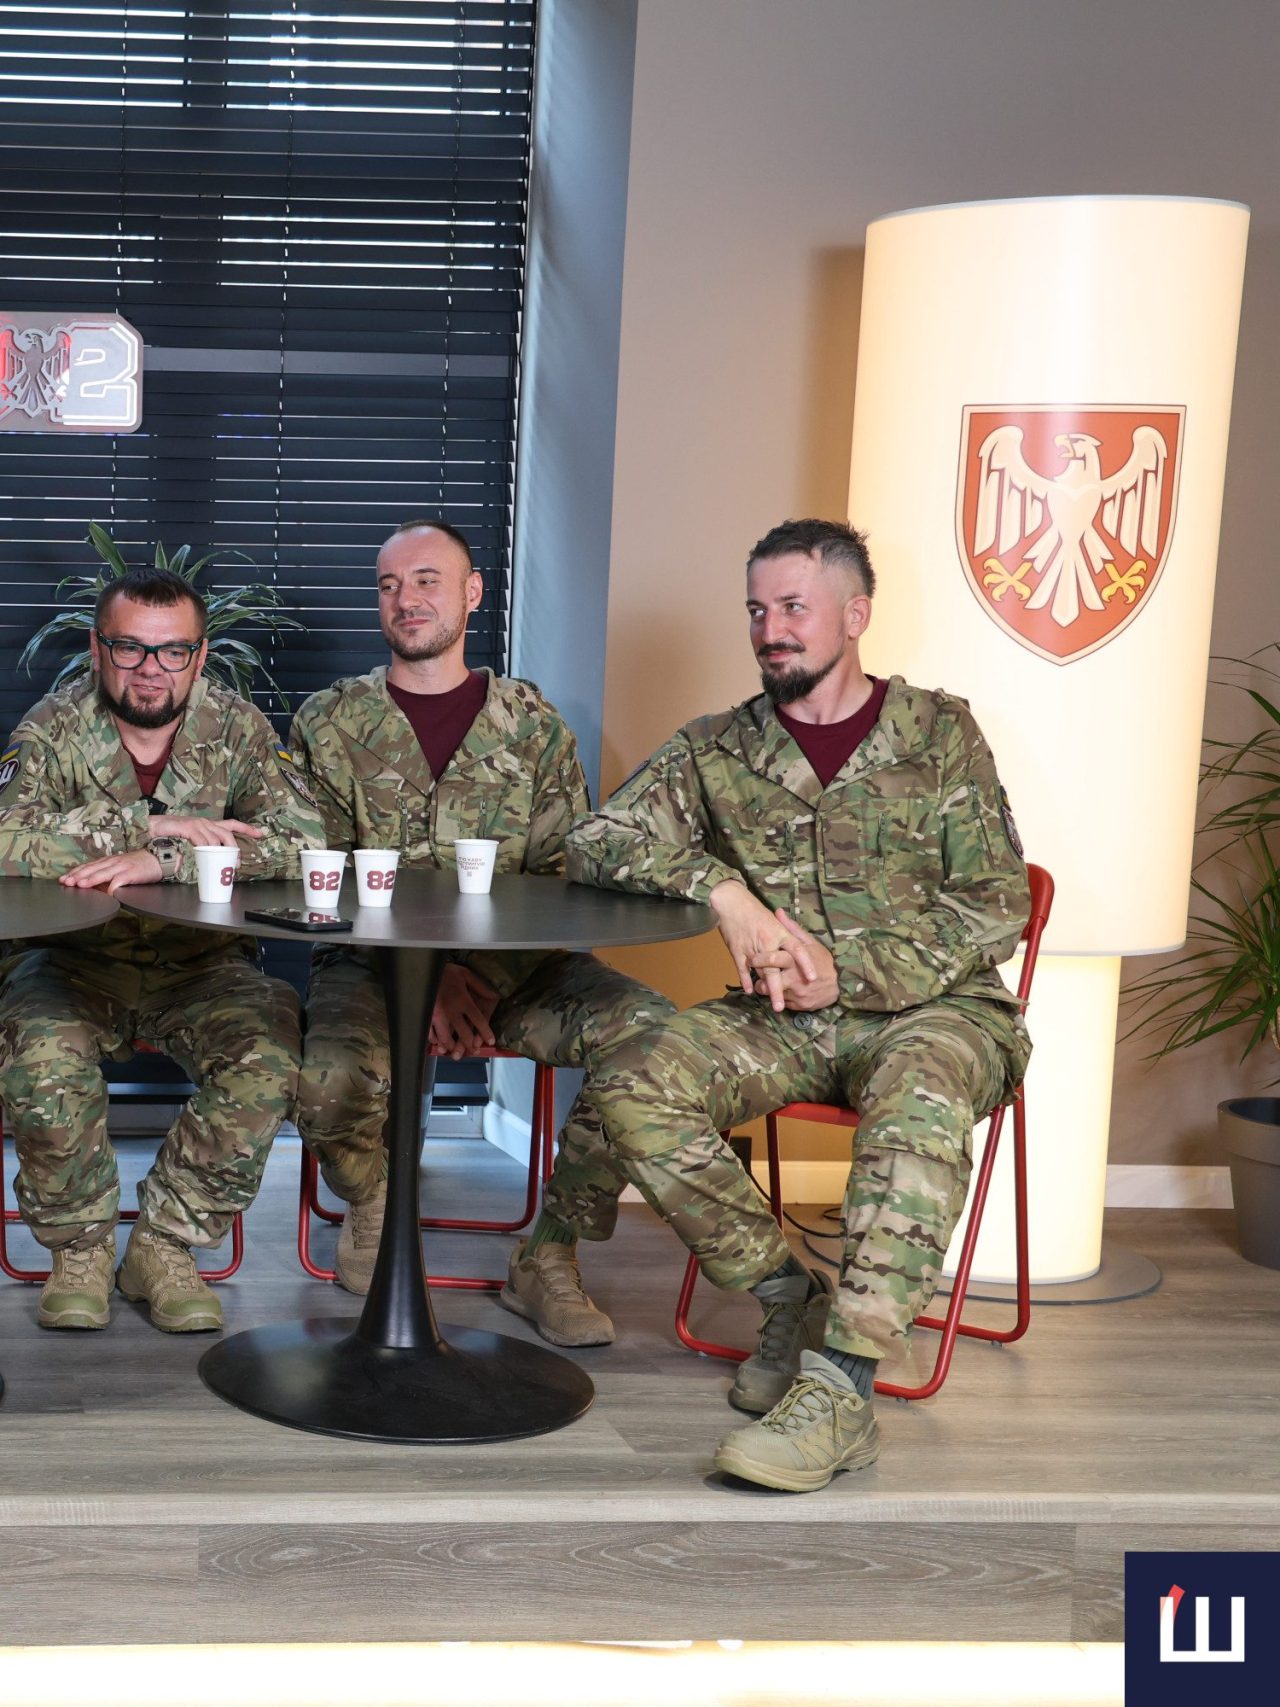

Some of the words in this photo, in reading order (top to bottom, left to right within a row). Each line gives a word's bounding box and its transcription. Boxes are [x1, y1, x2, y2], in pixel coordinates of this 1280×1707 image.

[220, 867, 234, 886] 8
[309, 870, 340, 891] 82
[367, 870, 395, 891] 82
